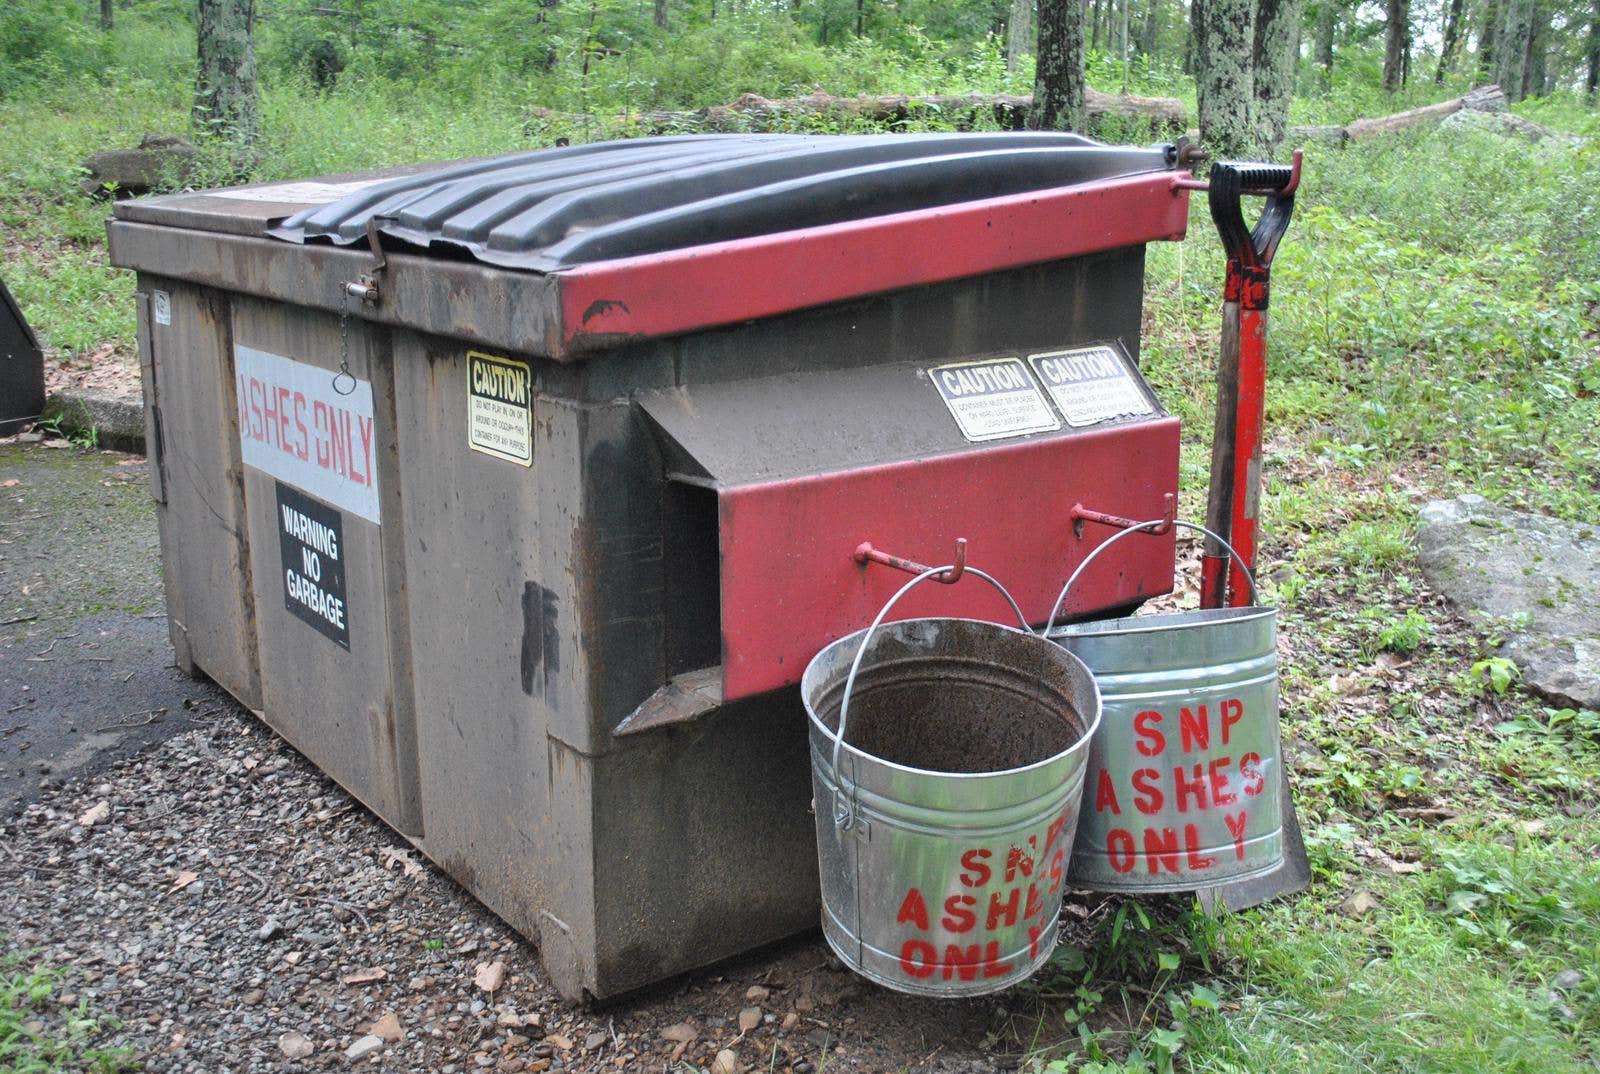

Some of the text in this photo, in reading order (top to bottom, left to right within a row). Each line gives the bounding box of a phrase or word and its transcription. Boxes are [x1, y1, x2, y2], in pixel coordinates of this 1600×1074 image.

[473, 360, 525, 404] CAUTION
[941, 364, 1027, 396] CAUTION
[1041, 353, 1121, 384] CAUTION
[240, 373, 372, 487] ASHES ONLY
[282, 504, 337, 560] WARNING
[302, 547, 320, 582] NO
[286, 568, 345, 630] GARBAGE
[1133, 698, 1244, 757] SNP
[1095, 751, 1265, 816] ASHES
[1106, 810, 1248, 876] ONLY
[900, 916, 1046, 981] ONLY
